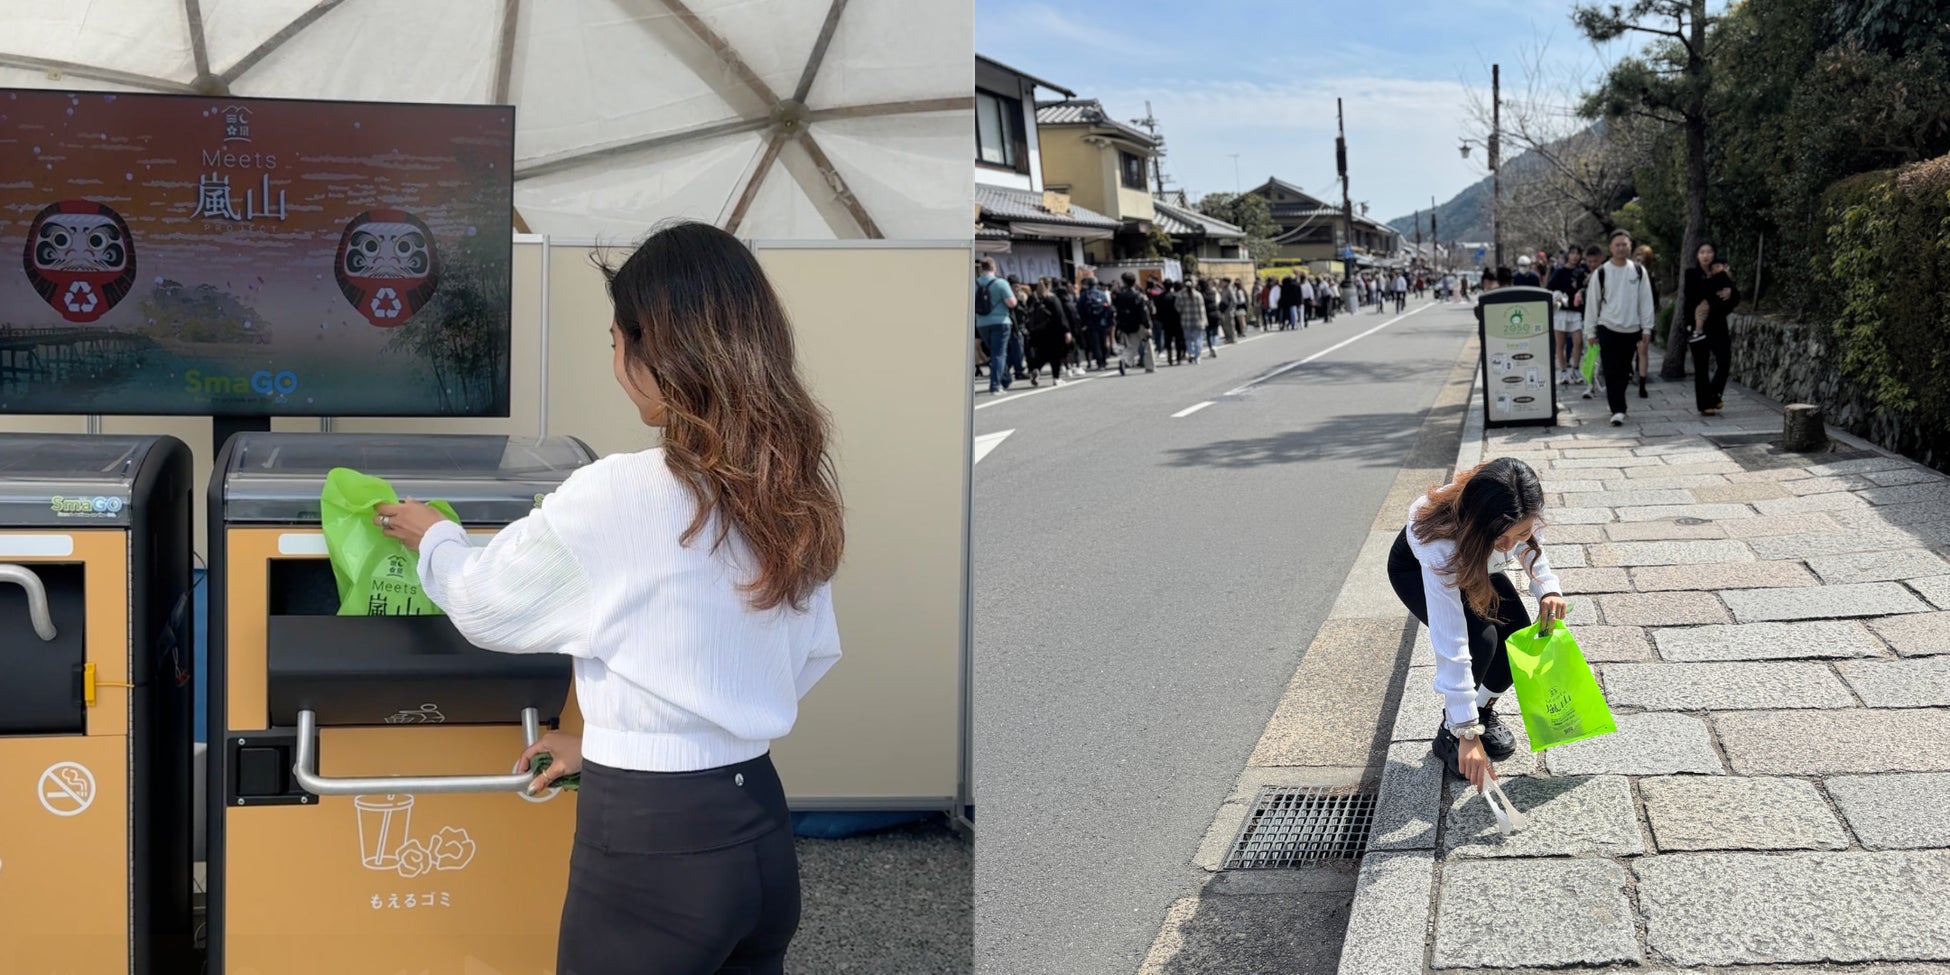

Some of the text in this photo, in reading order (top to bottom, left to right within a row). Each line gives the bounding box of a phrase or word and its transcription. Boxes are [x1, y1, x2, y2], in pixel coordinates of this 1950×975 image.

[203, 149, 277, 169] Meets
[190, 171, 288, 220] 嵐山
[184, 369, 298, 394] SmaGO
[51, 495, 122, 512] SmaGO
[371, 580, 417, 595] Meets
[371, 892, 450, 910] もえるゴミ
